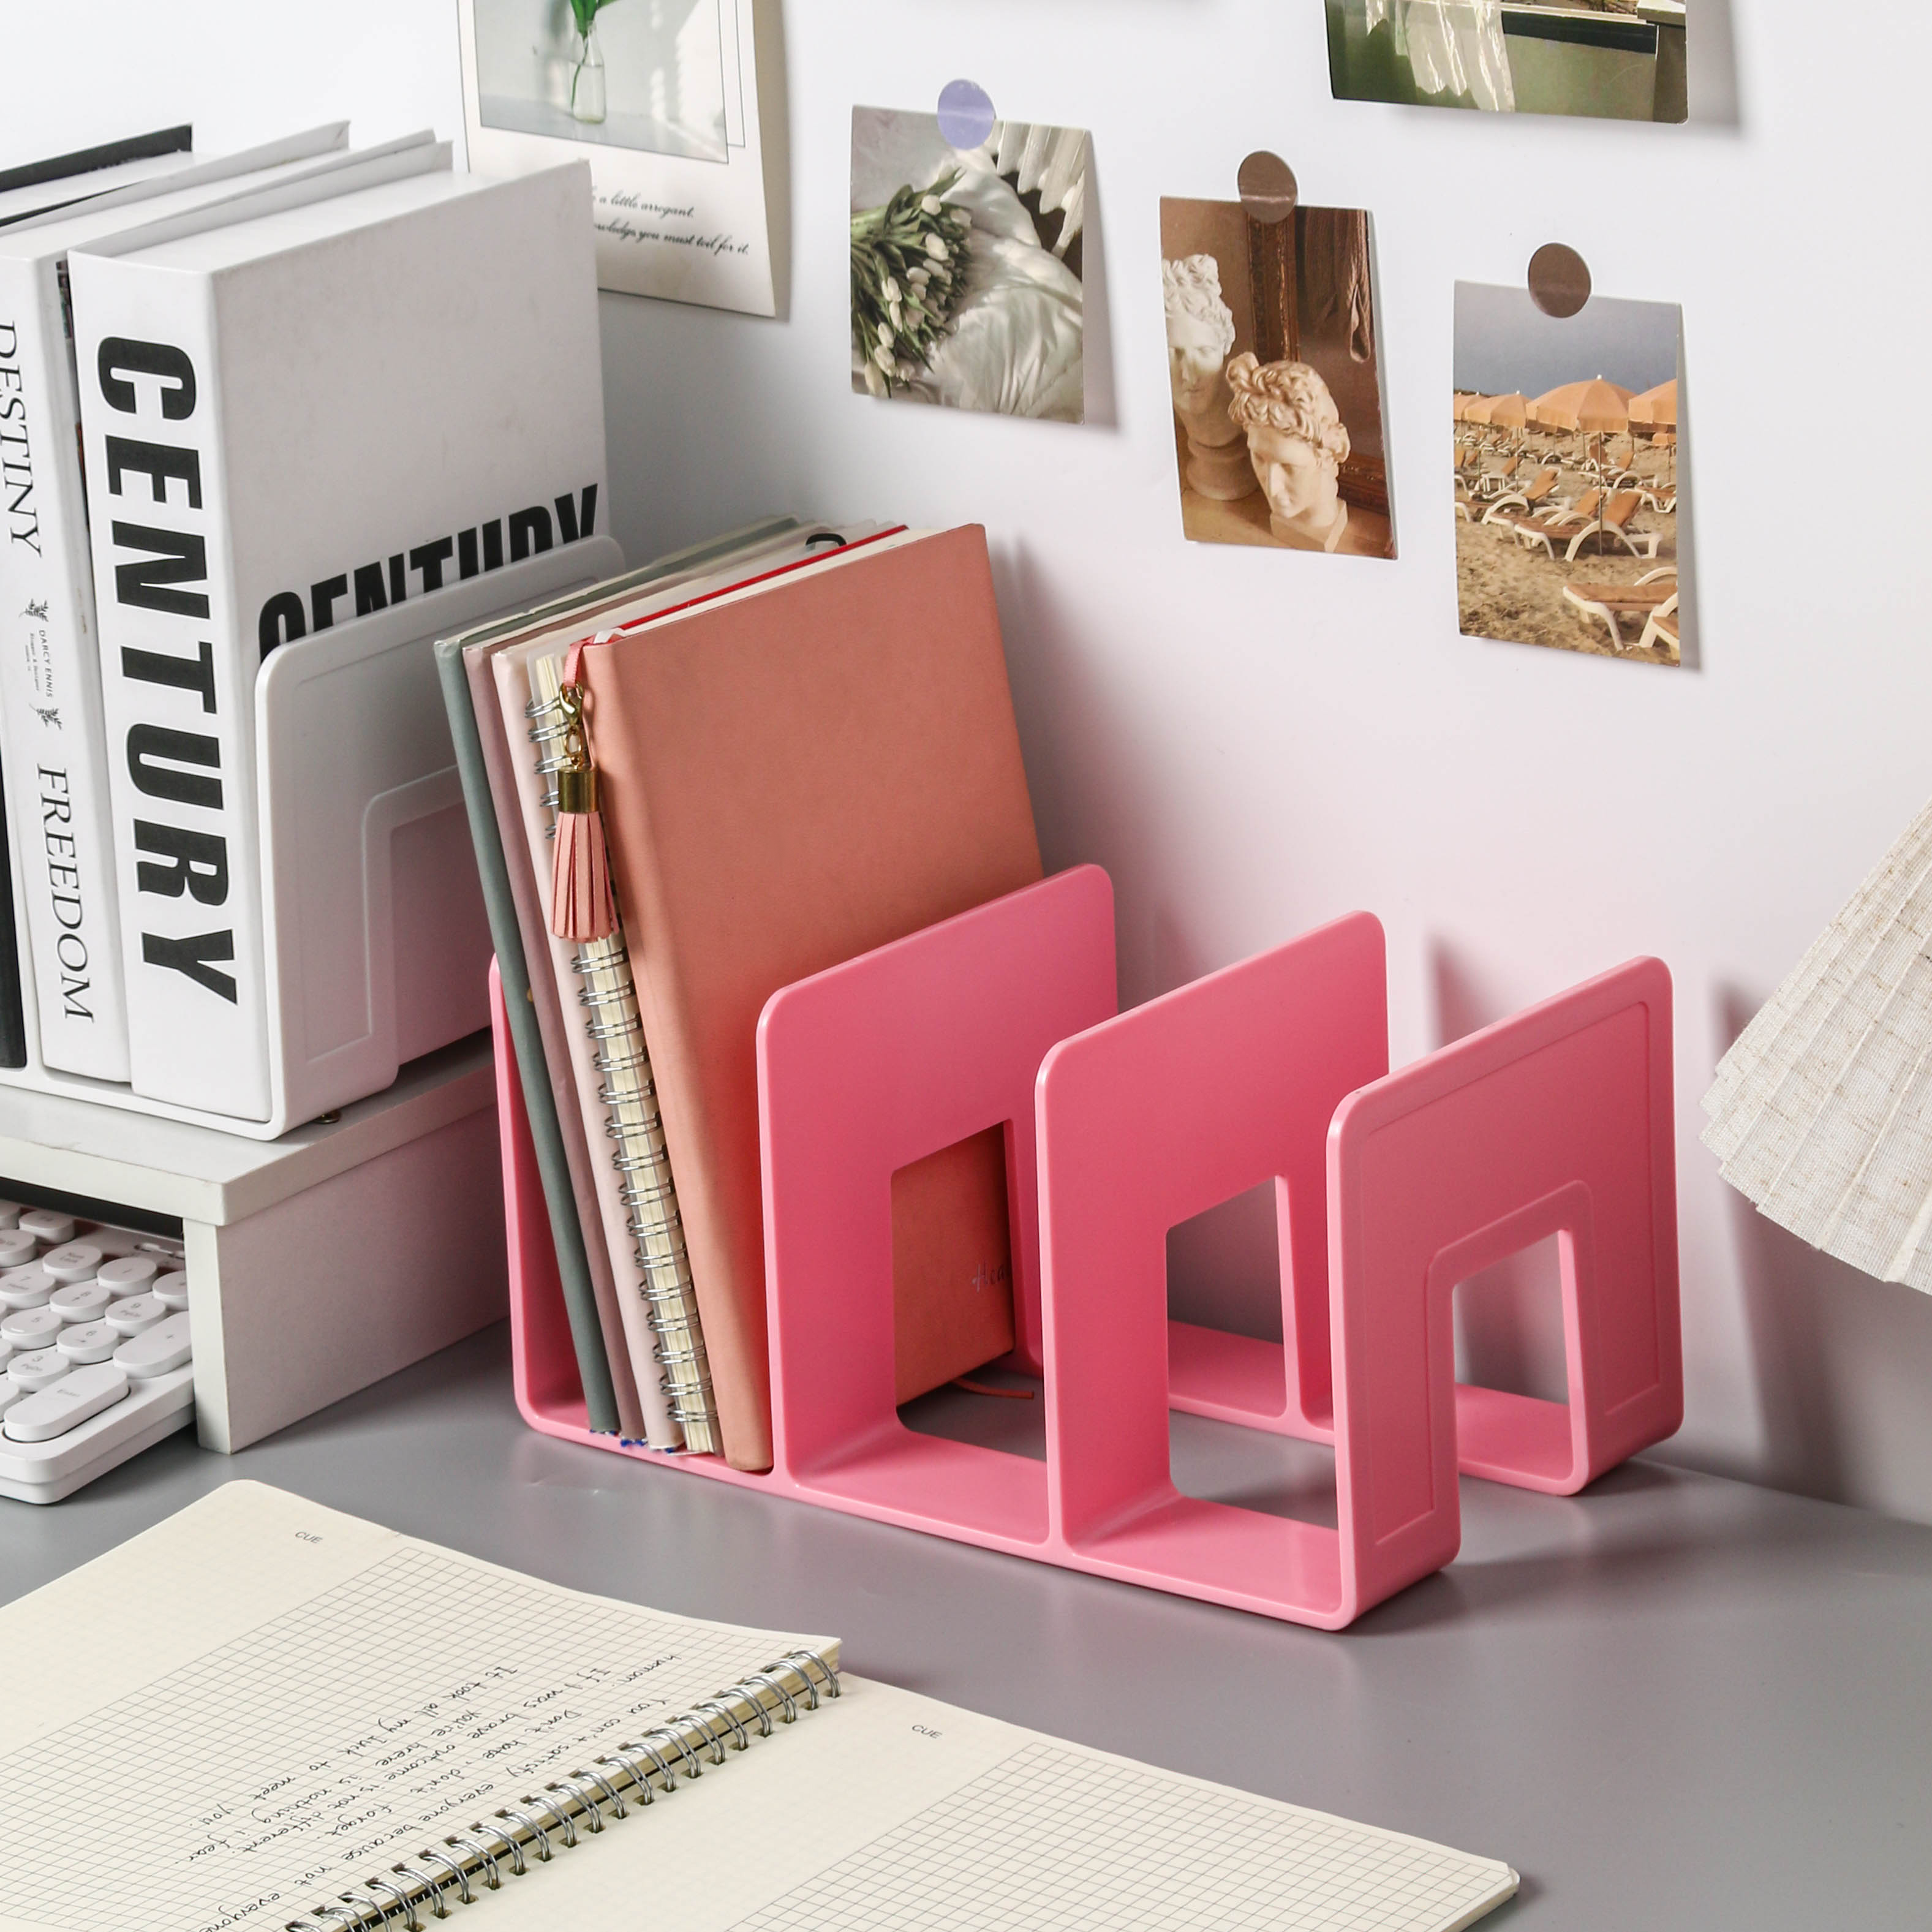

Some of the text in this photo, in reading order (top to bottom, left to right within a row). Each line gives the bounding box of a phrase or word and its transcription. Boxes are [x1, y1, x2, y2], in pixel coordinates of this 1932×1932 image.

[611, 189, 641, 208] little
[635, 231, 659, 243] you
[663, 234, 695, 245] must
[713, 235, 733, 256] for
[0, 320, 42, 559] DESTINY
[39, 629, 50, 665] DARCY
[97, 336, 238, 1005] CENTURY
[37, 763, 94, 1022] FREEDOM
[295, 1531, 323, 1543] CUE
[483, 1666, 518, 1679] It
[575, 1667, 611, 1682] If
[439, 1681, 487, 1702] took
[522, 1689, 563, 1708] was
[412, 1702, 438, 1718] all
[625, 1697, 670, 1714] You
[376, 1716, 412, 1734] my
[466, 1712, 530, 1740] brave
[524, 1708, 581, 1733] Don't
[572, 1718, 620, 1742] can't
[911, 1724, 943, 1738] CUE
[308, 1759, 331, 1772] to
[382, 1743, 455, 1781] outcome
[248, 1776, 296, 1801] meet
[338, 1774, 362, 1784] is
[358, 1783, 383, 1792] is
[409, 1768, 464, 1794] don't
[250, 1787, 332, 1824] nothing
[326, 1793, 360, 1809] not
[417, 1783, 493, 1822] everyone
[340, 1823, 423, 1860] because
[293, 1865, 331, 1885] not
